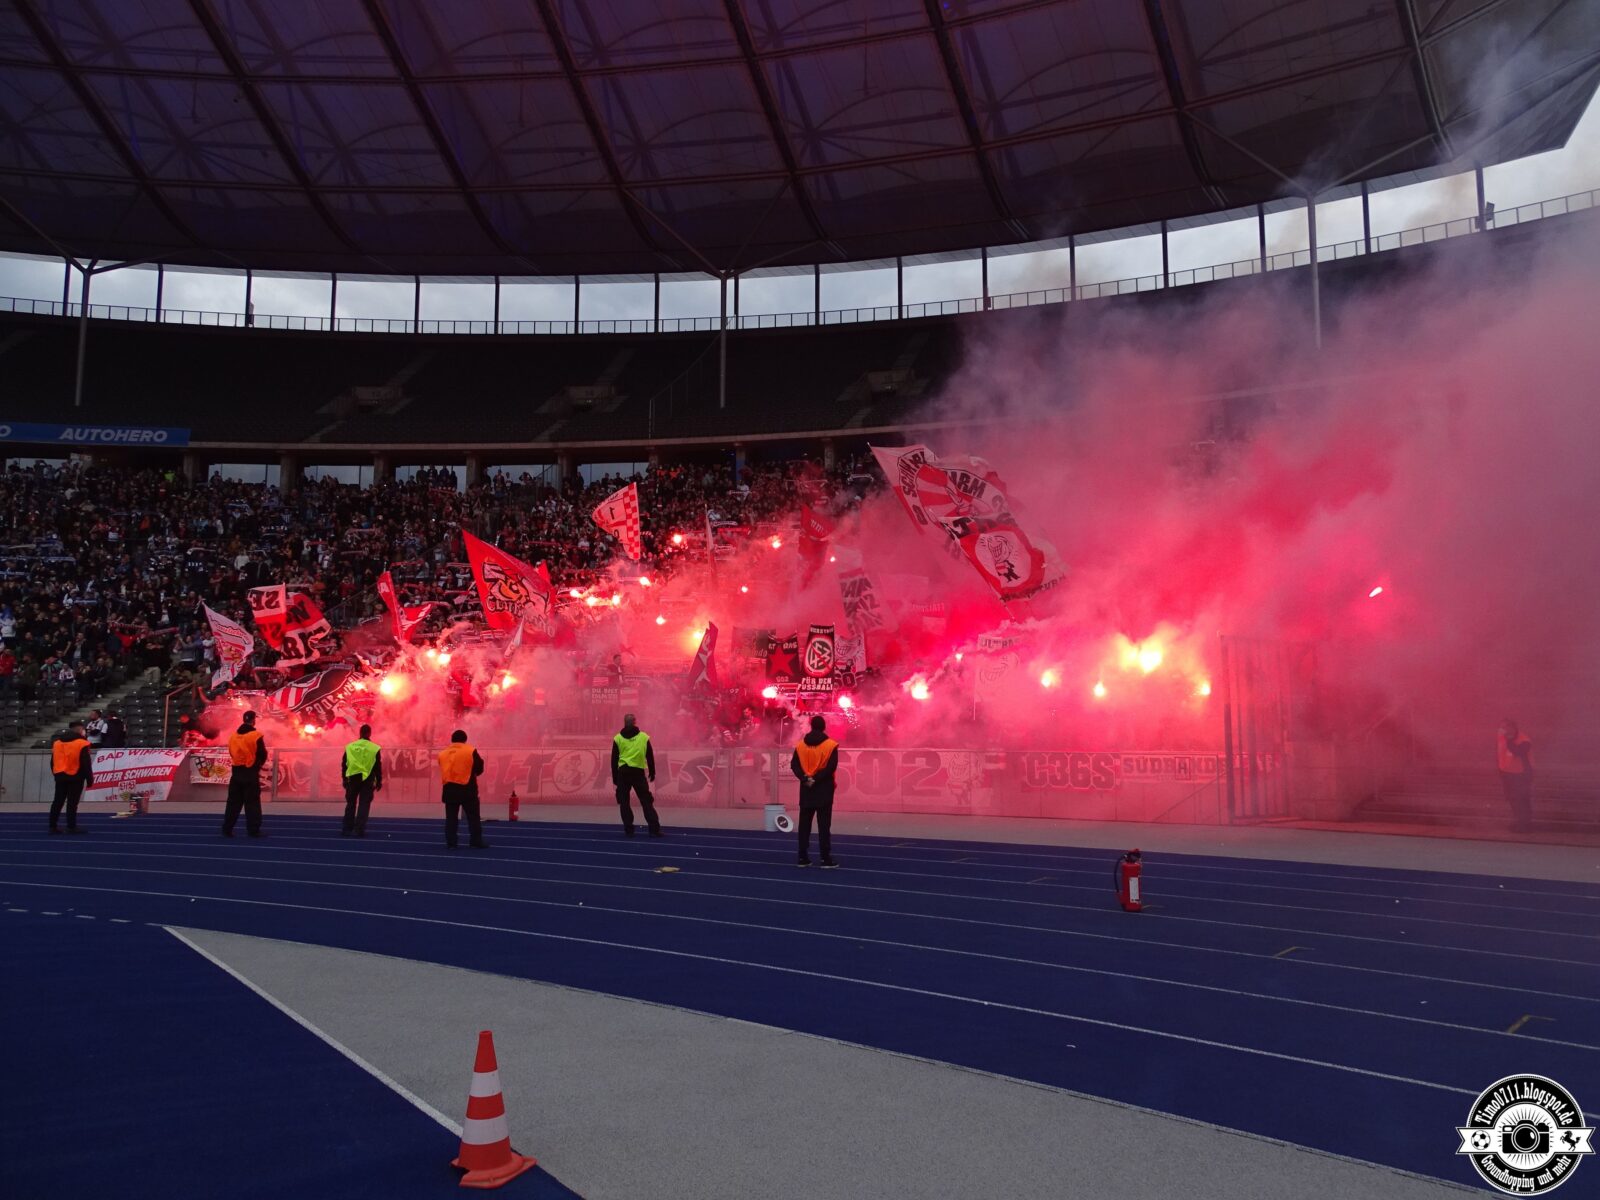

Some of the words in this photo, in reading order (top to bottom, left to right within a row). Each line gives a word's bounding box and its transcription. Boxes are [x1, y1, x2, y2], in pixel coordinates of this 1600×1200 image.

[59, 427, 168, 443] AUTOHERO
[97, 751, 125, 763] BAD
[128, 749, 182, 759] WIMPFEN
[93, 772, 123, 784] TAUFER
[124, 767, 173, 780] SCHWABEN
